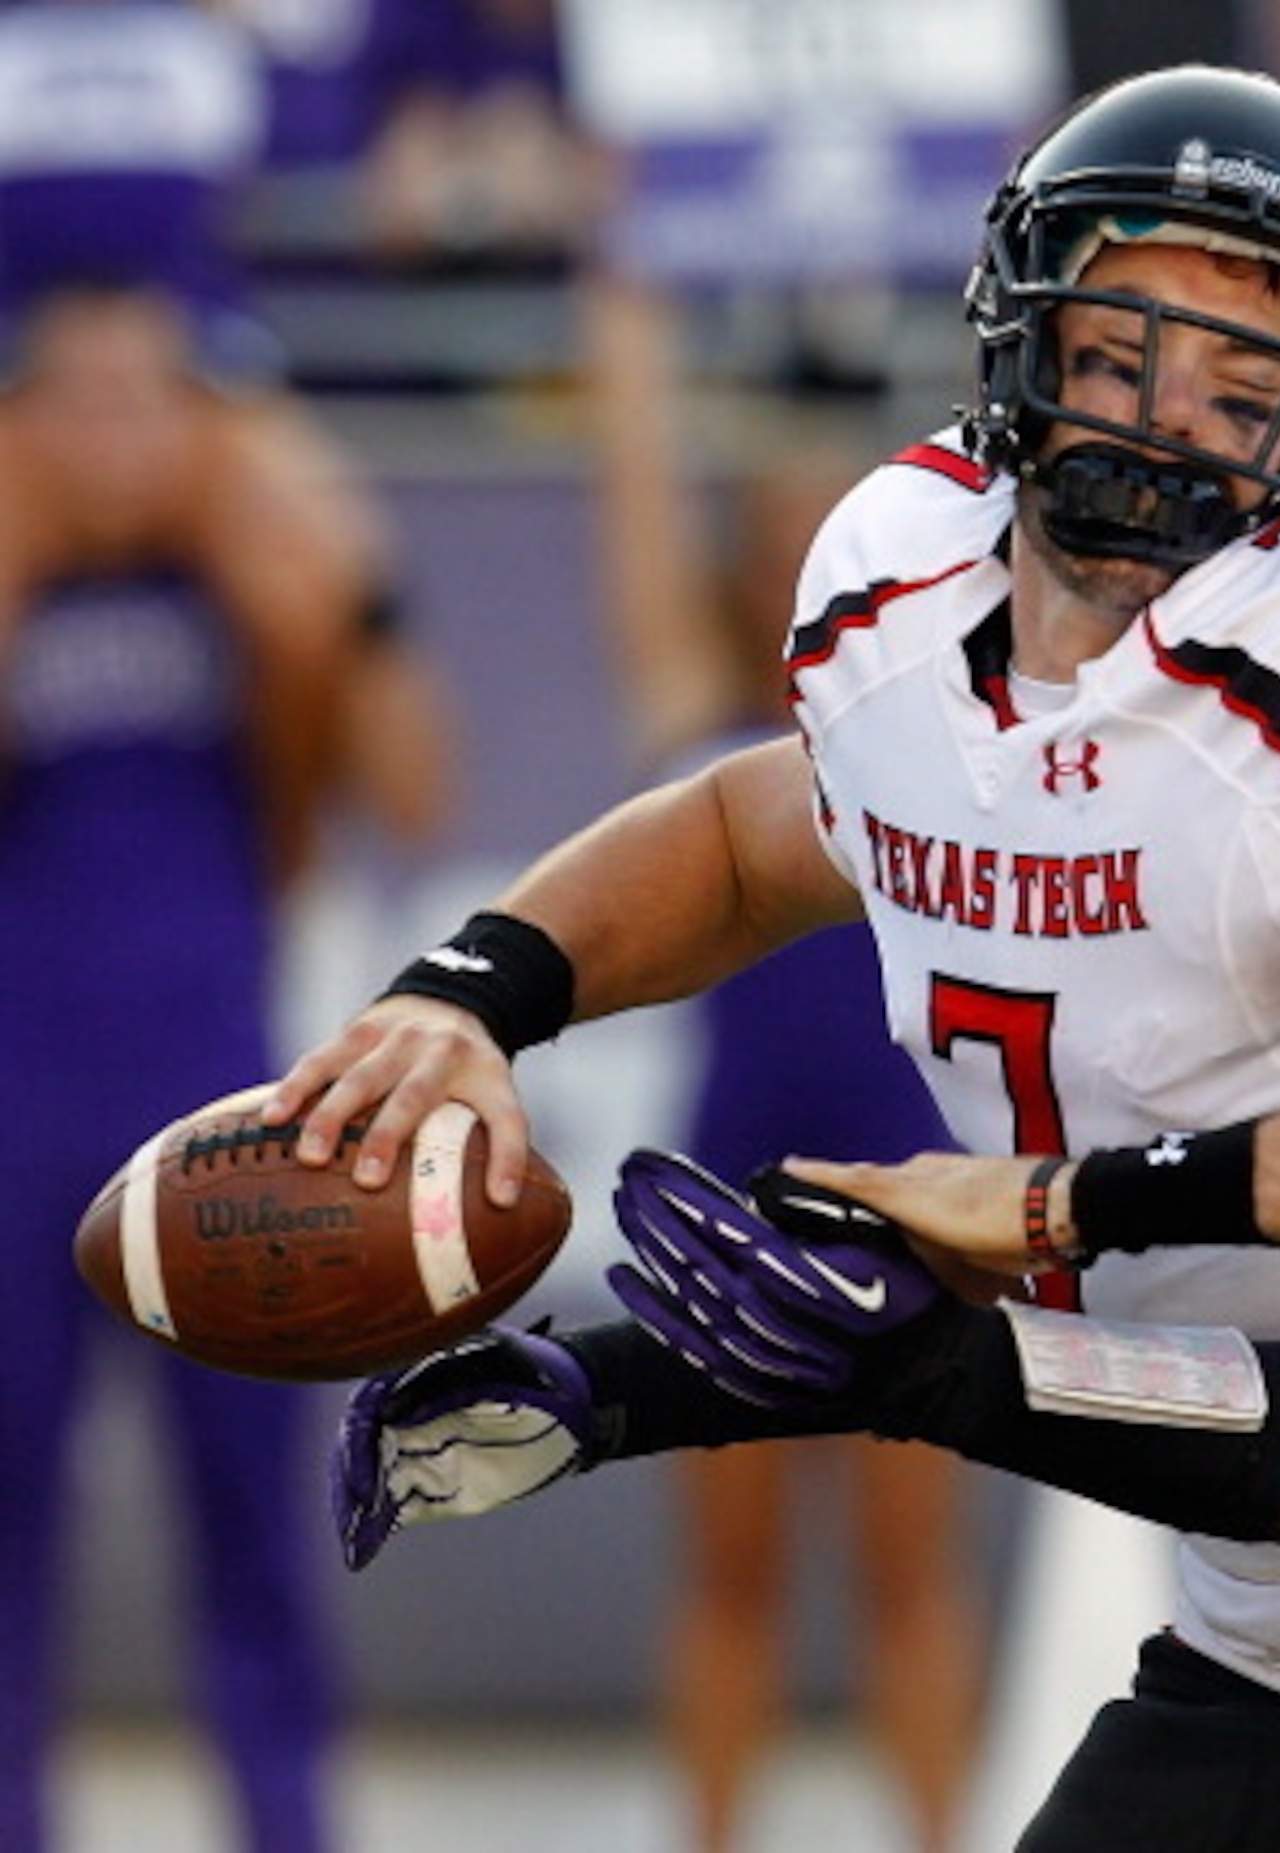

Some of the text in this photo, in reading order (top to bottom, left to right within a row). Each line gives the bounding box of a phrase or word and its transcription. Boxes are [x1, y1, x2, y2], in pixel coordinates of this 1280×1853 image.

[862, 807, 1149, 938] TEXAS TECH
[196, 1194, 356, 1240] Wilson
